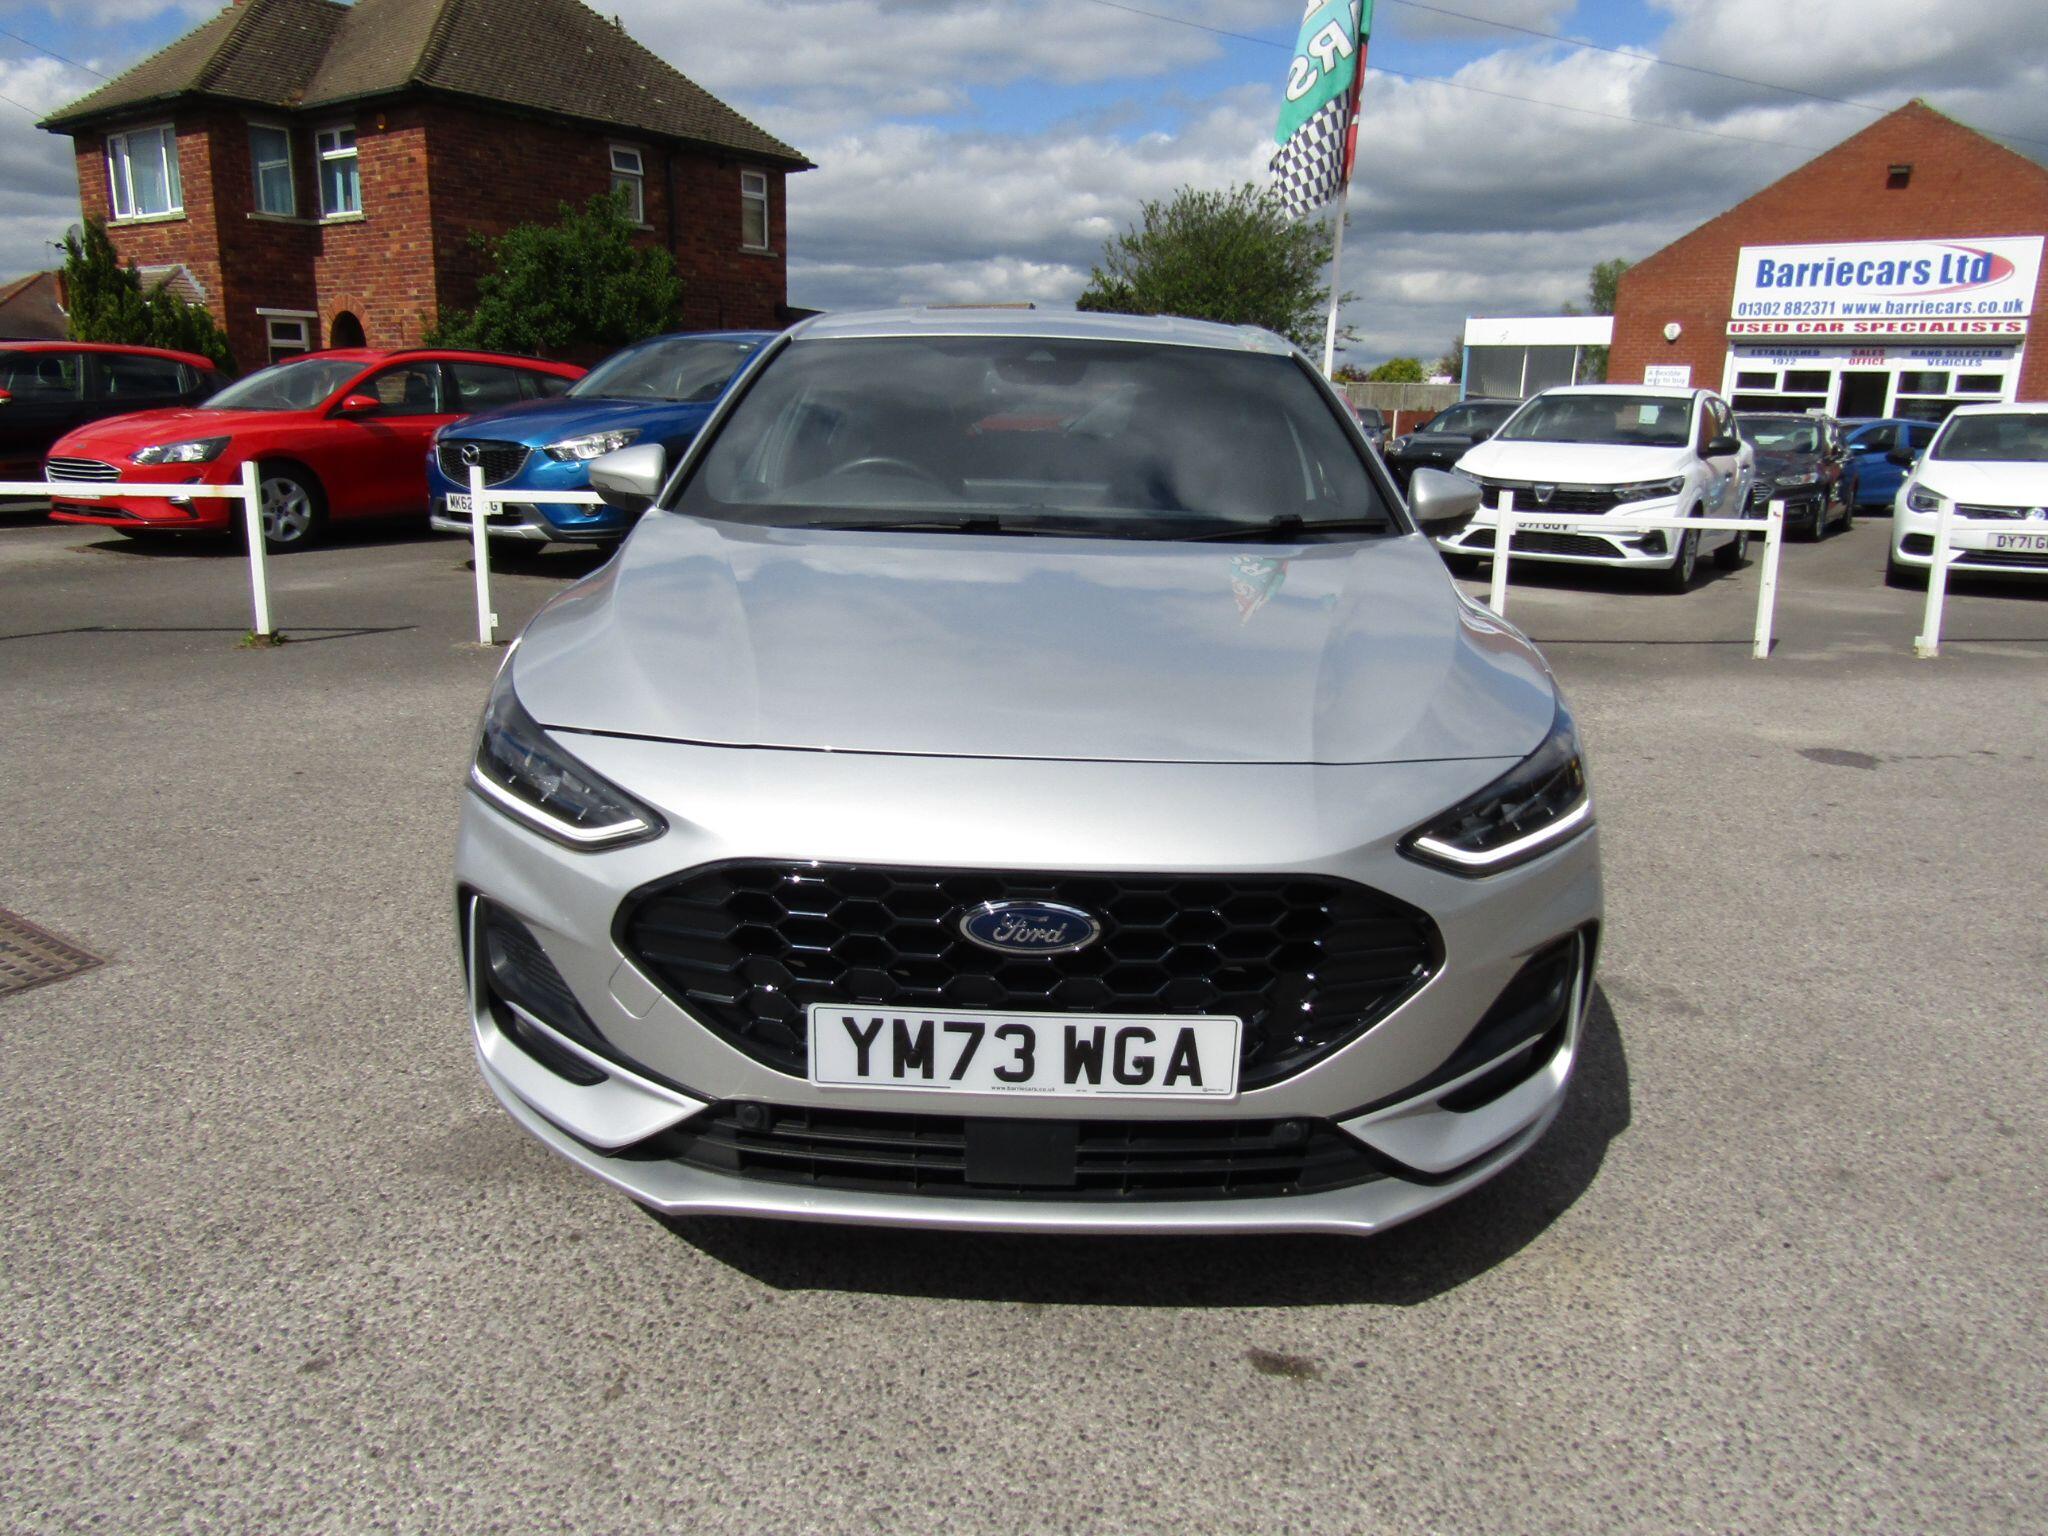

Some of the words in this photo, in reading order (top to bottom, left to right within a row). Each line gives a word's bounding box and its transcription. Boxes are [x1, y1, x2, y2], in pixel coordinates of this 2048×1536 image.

[1755, 257, 1932, 288] Barriecars
[1939, 252, 1993, 284] Ltd
[1738, 302, 1781, 316] 01302
[1784, 301, 1836, 316] 882371
[1842, 298, 2024, 315] www.barriecars.co.uk
[1730, 323, 1789, 333] USED
[1796, 323, 1844, 333] CAR
[1853, 321, 2022, 333] SPECIALISTS
[1750, 349, 1821, 357] ESTABLISHED
[1851, 348, 1886, 357] SALES
[1911, 349, 1942, 357] HAND
[1945, 349, 2002, 358] SELECTED
[1848, 358, 1886, 366] OFFICE
[1927, 359, 1983, 367] VEHICLES
[1996, 535, 2032, 549] DY71
[993, 912, 1068, 943] Ford
[842, 1016, 1036, 1083] YM73
[1064, 1025, 1204, 1087] WGA
